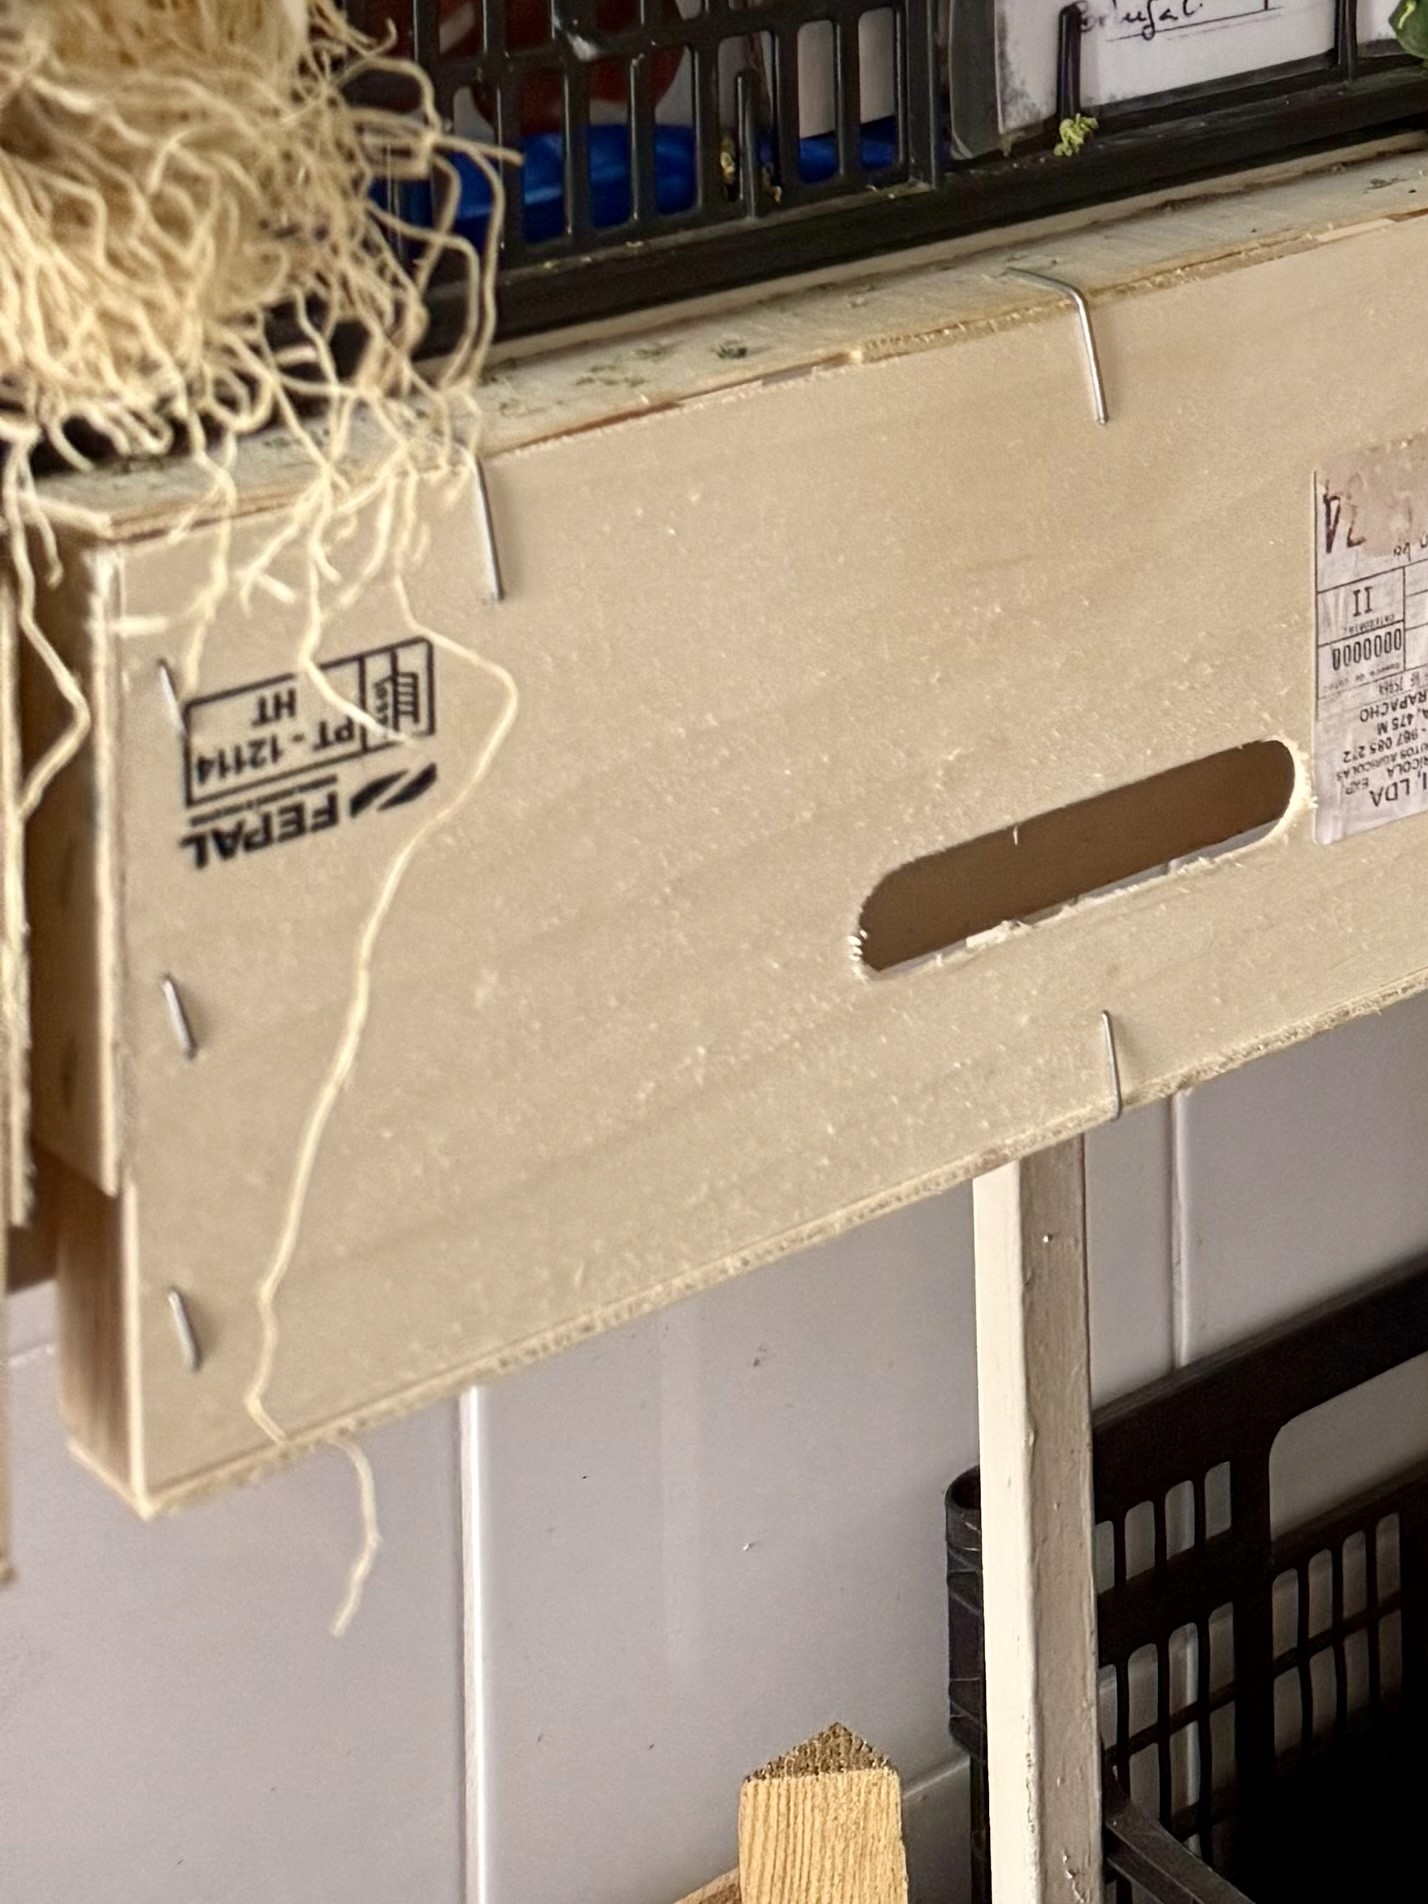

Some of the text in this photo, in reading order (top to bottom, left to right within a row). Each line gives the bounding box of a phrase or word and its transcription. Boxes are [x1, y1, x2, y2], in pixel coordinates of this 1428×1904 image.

[1352, 585, 1372, 618] II
[252, 688, 297, 727] HT
[312, 716, 355, 752] PT
[1377, 720, 1387, 735] M
[197, 735, 283, 785] 12114
[1369, 777, 1409, 808] LDA
[180, 790, 339, 870] FEPAL
